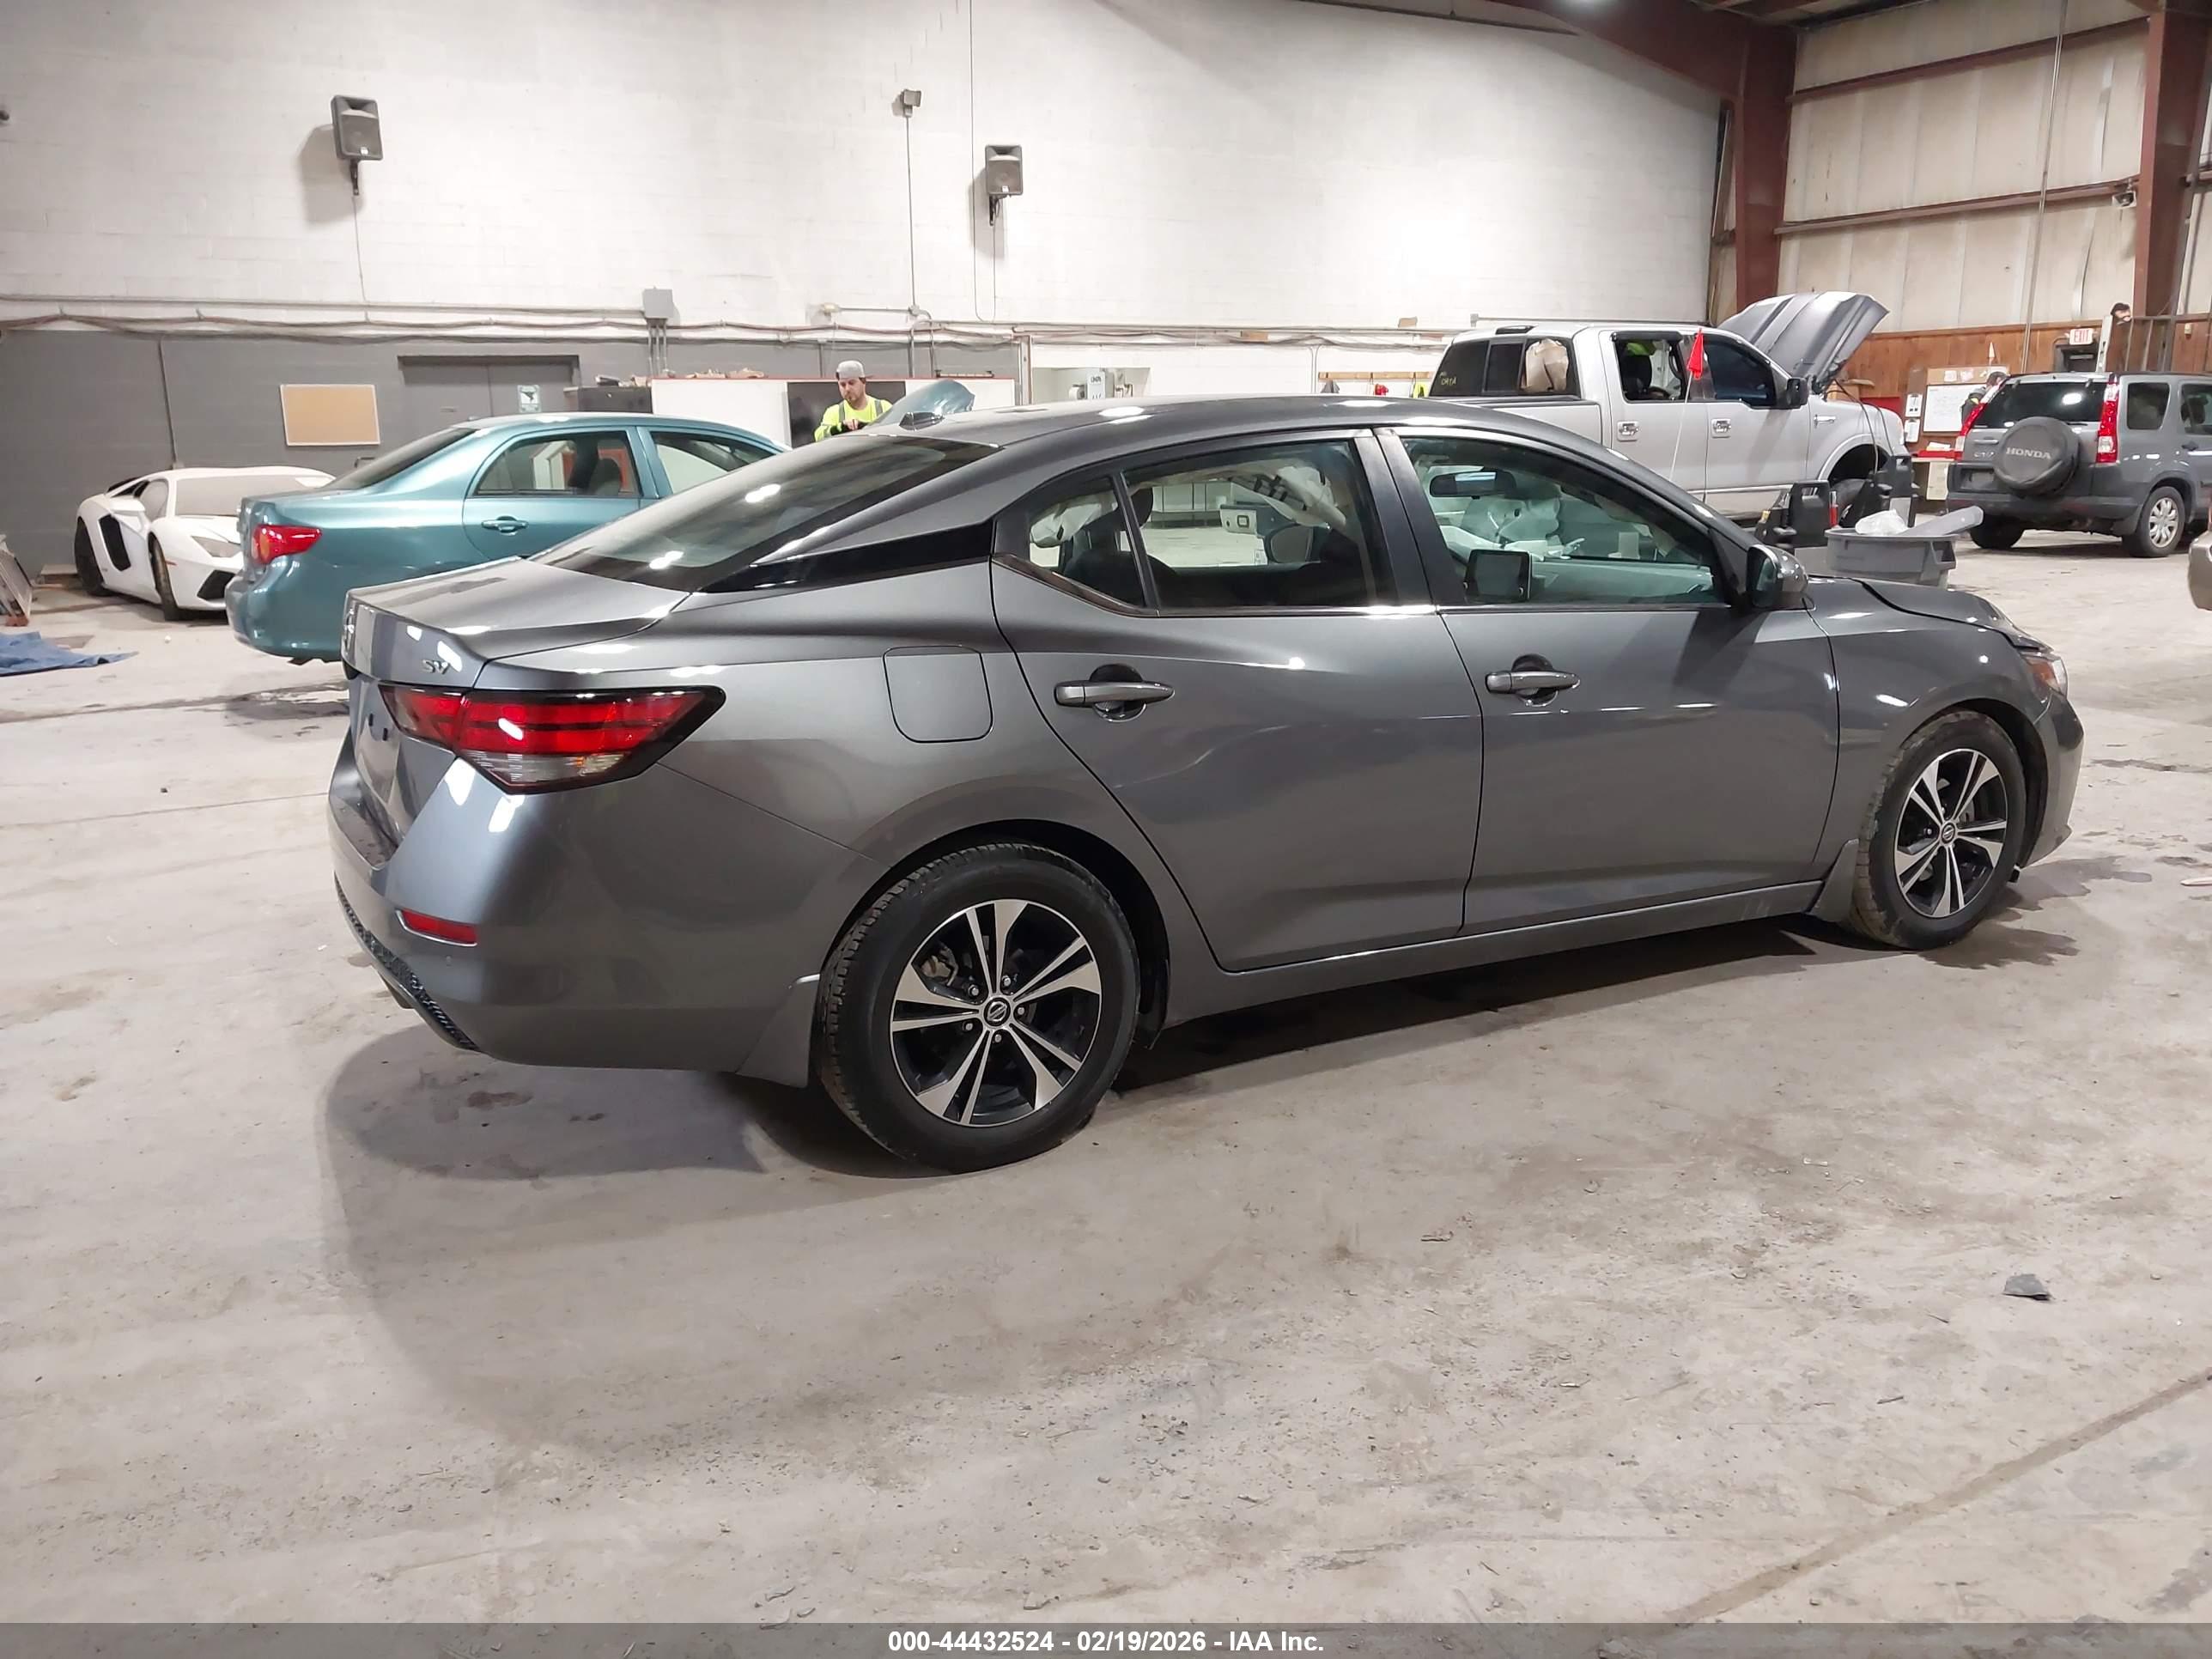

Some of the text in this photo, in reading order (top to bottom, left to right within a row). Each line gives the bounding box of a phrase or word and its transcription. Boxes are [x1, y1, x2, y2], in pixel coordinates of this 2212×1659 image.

[2074, 329, 2090, 343] EXIT
[2006, 447, 2051, 459] HONDA
[422, 659, 451, 675] SV
